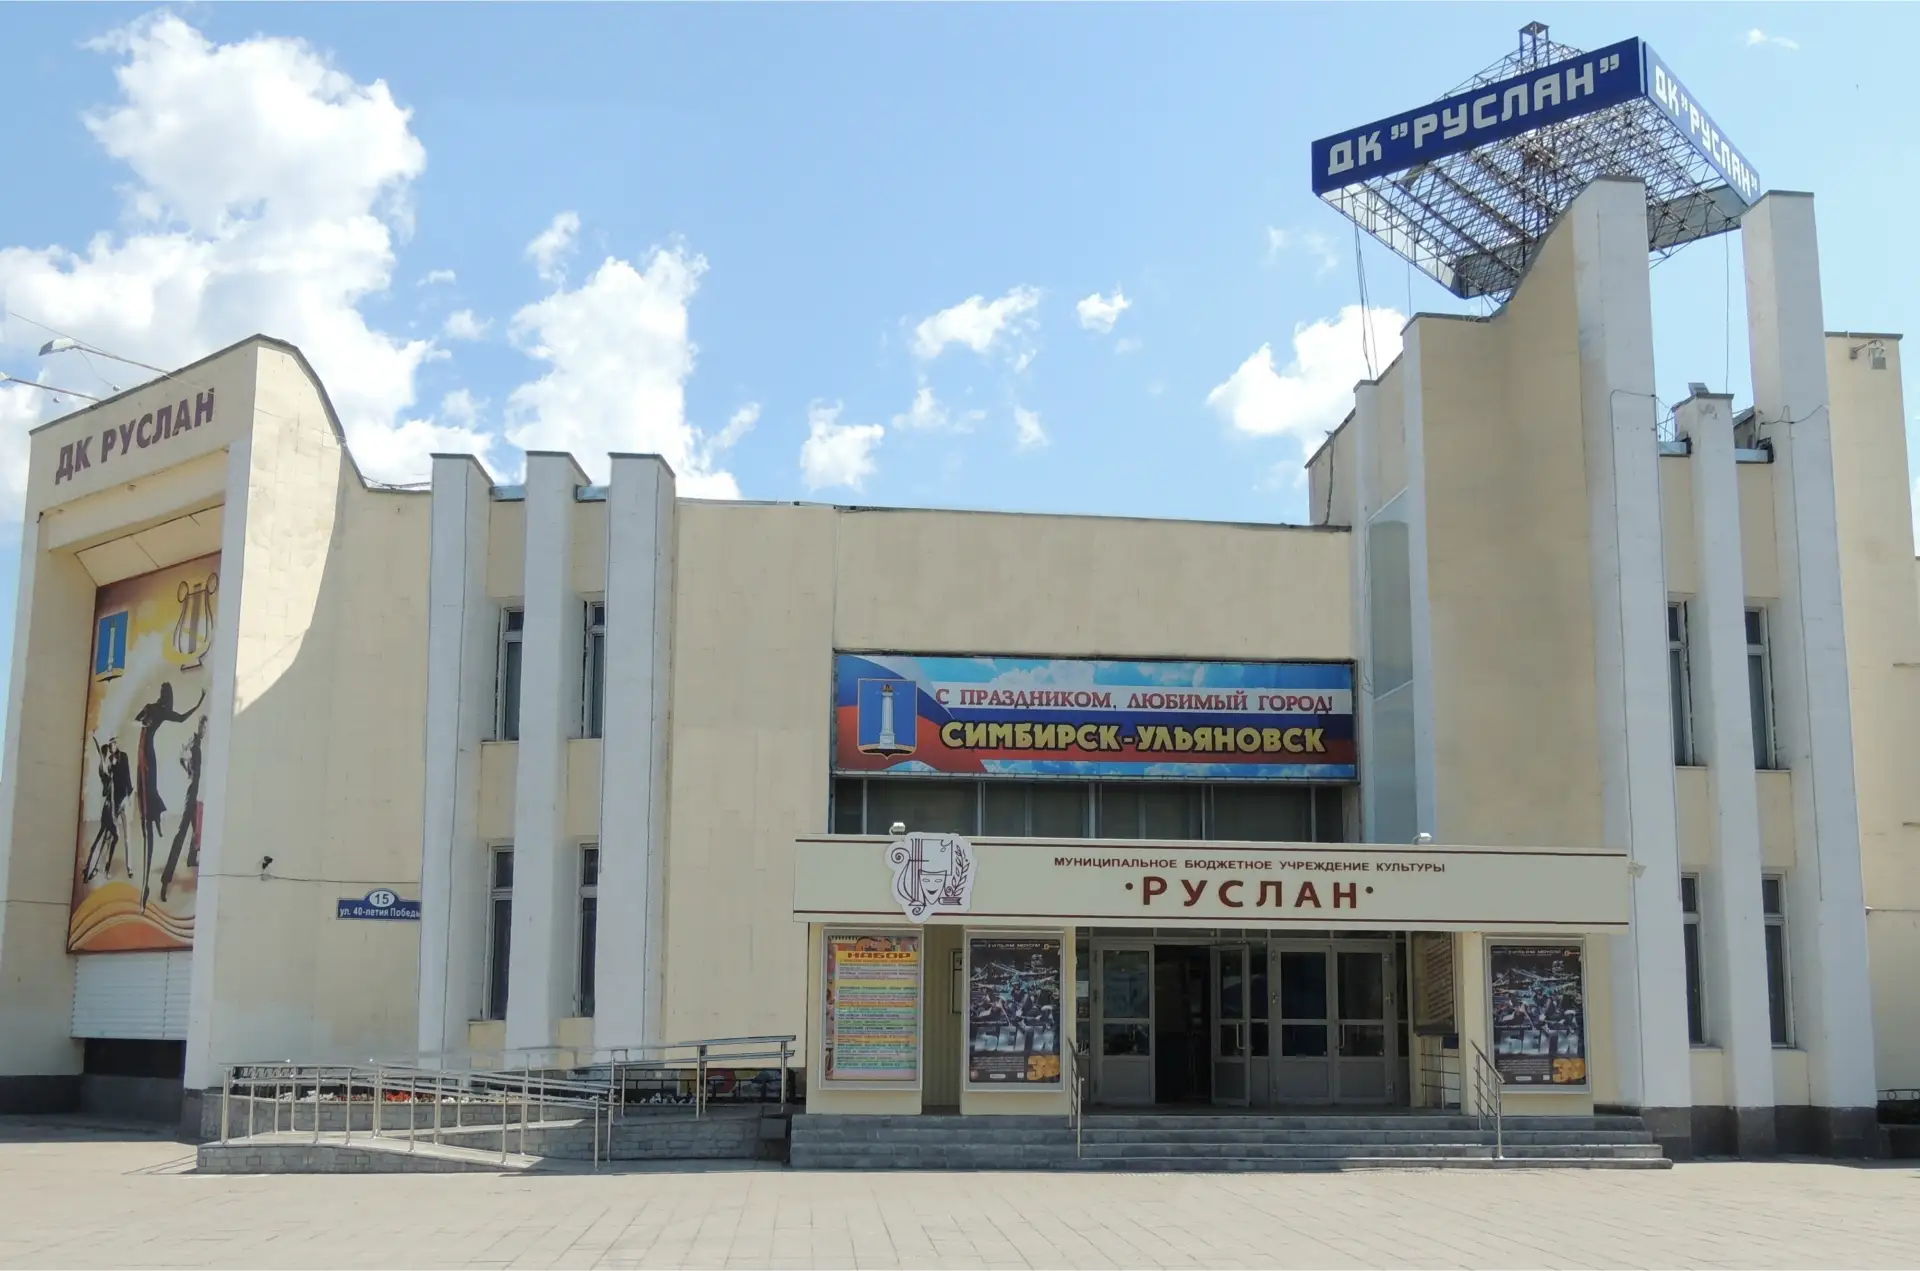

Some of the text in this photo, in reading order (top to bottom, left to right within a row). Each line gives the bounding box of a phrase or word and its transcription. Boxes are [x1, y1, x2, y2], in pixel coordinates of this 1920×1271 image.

[1655, 64, 1680, 117] ДК
[1327, 129, 1382, 176] ДК
[55, 387, 215, 486] ДК РУСЛАН
[936, 688, 1333, 714] С ПРАЗДНИКОМ, ЛЮБИМЫЙ ГОРОД!
[940, 721, 1326, 754] СИМБИРСК-УЛЬЯНОВСК
[1053, 857, 1446, 873] МУНИЦИПАЛЬНОЕ БЮДЖЕТНОЕ УЧРЕЖДЕНИЕ КУЛЬТУРЫ
[374, 893, 390, 905] 15
[1142, 876, 1358, 909] РУСЛАН
[339, 908, 351, 917] ул.
[353, 906, 389, 917] 40-летия
